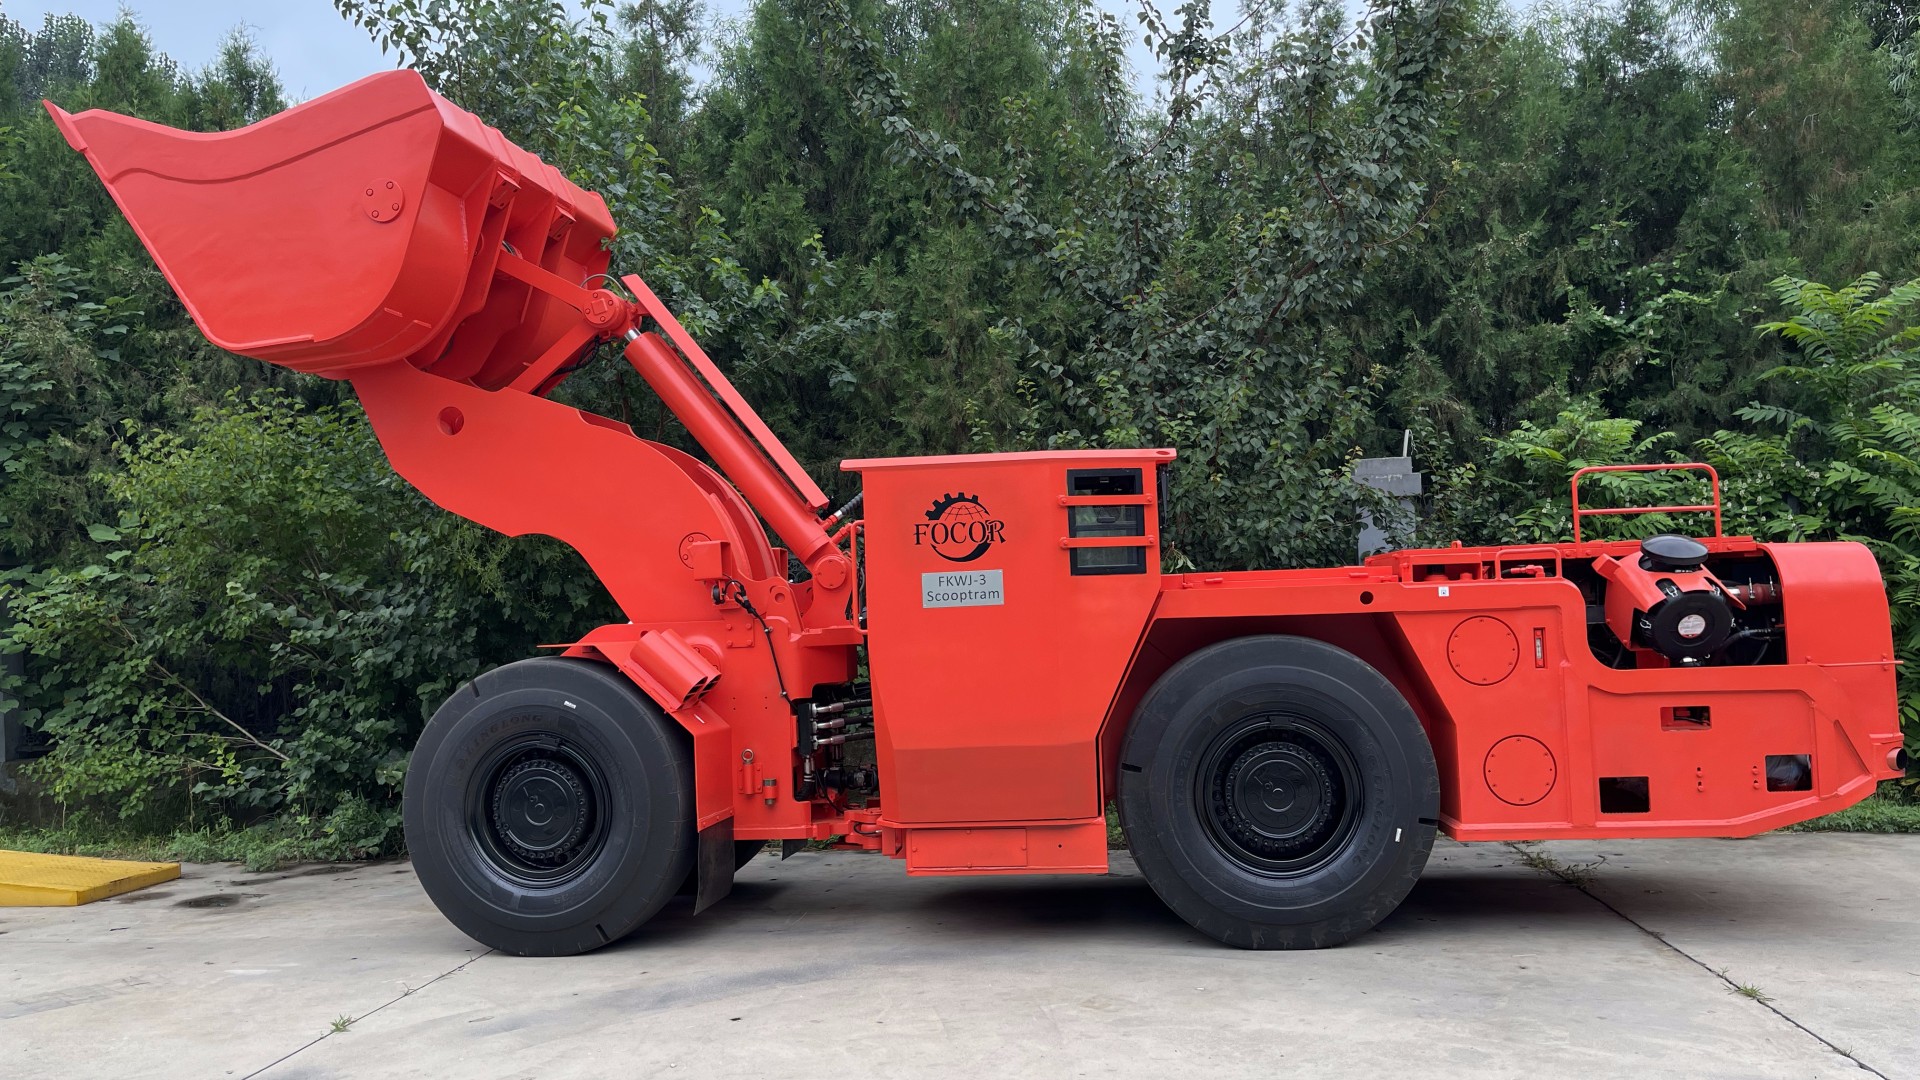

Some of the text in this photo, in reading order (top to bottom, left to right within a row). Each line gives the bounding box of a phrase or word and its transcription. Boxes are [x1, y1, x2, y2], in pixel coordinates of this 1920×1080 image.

[913, 519, 1006, 545] FOCOR
[938, 574, 987, 587] FKWJ-3
[927, 589, 1000, 603] Scooptram
